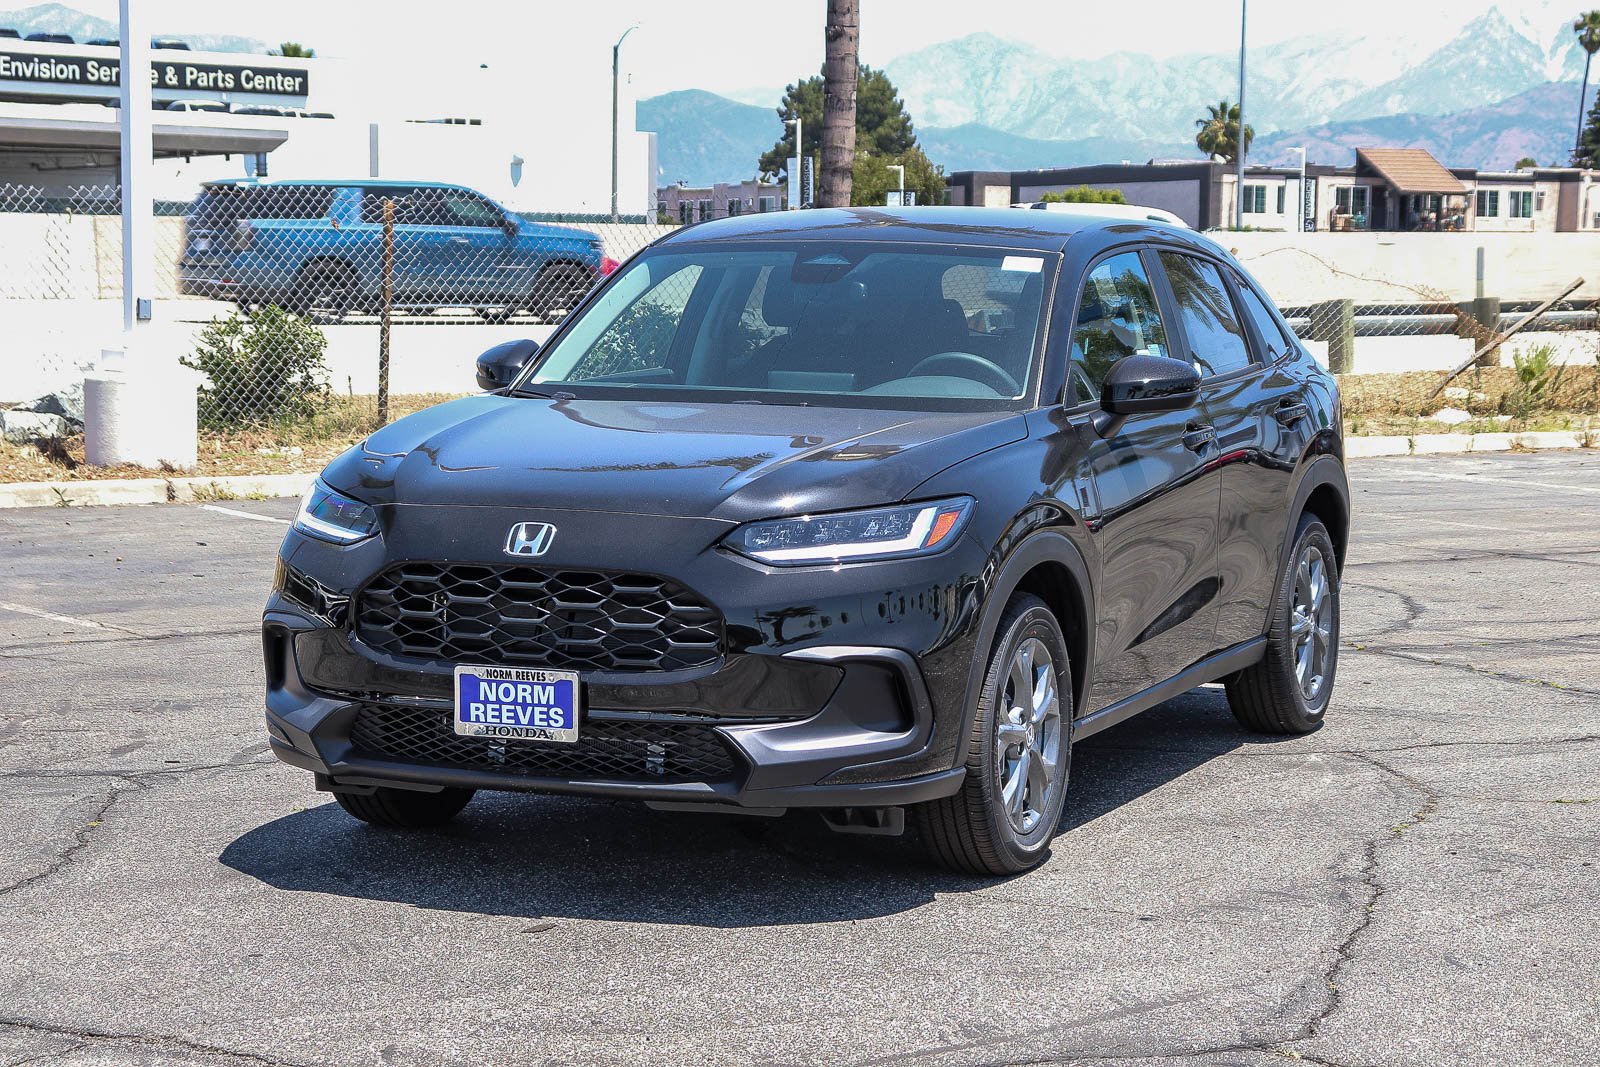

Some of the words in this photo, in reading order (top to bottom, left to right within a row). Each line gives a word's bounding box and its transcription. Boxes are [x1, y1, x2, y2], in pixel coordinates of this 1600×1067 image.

[0, 55, 80, 81] Envision
[86, 60, 159, 85] Sere
[165, 65, 179, 86] &
[185, 66, 235, 89] Parts
[240, 69, 304, 93] Center
[486, 668, 513, 680] NORM
[515, 670, 546, 682] REEVES
[479, 681, 555, 706] NORM
[469, 702, 565, 728] REEVES
[484, 725, 550, 739] HONDA
